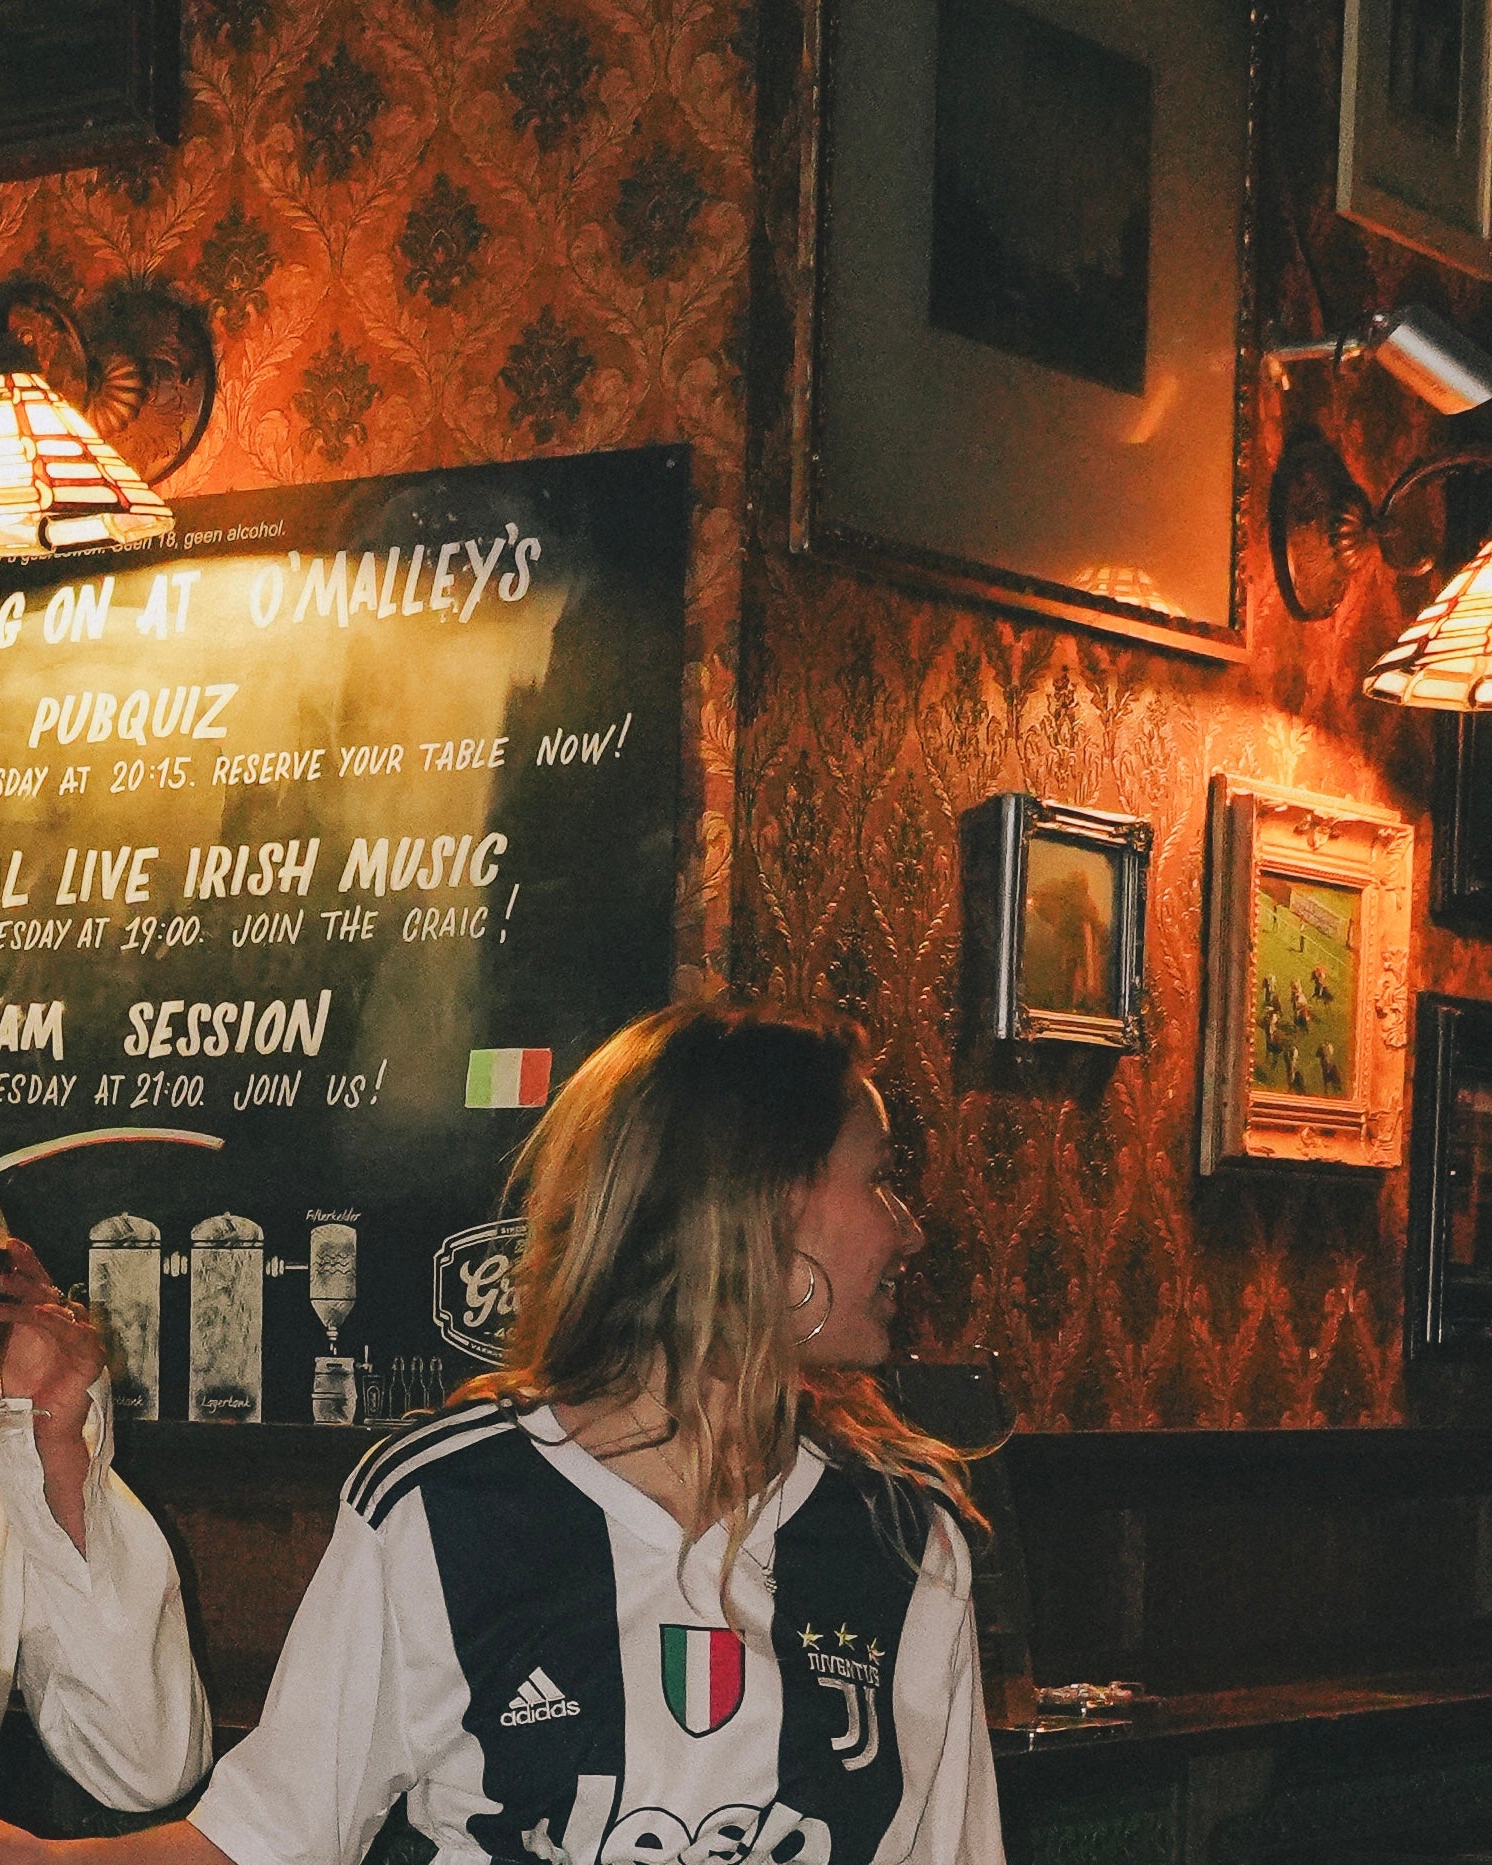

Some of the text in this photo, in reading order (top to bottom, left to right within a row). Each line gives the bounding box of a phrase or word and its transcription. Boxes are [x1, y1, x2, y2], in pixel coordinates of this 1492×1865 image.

[158, 530, 179, 550] 18,
[183, 528, 223, 550] geen
[227, 520, 286, 542] alcohol.
[43, 575, 115, 644] ON
[135, 568, 200, 640] AT
[248, 521, 542, 629] O'MALLEY'S
[28, 682, 240, 749] PUBQUIZ
[59, 765, 91, 795] AT
[110, 754, 195, 794] 20:15.
[211, 748, 326, 786] RESERVE
[337, 743, 404, 779] YOUR
[419, 736, 509, 772] TABLE
[536, 712, 633, 767] NOW!
[56, 846, 160, 906] LIVE
[183, 838, 319, 901] IRISH
[338, 831, 509, 899] MUSIC
[75, 916, 111, 950] AT
[120, 915, 205, 954] 19:00.
[231, 909, 304, 949] JOIN
[320, 907, 379, 942] THE
[123, 989, 333, 1061] SESSION
[94, 1073, 125, 1106] AT
[130, 1072, 205, 1109] 21:00.
[233, 1070, 302, 1110] JOIN
[325, 1058, 388, 1109] US!
[201, 1395, 251, 1414] Lagertank
[500, 1696, 581, 1728] adidas
